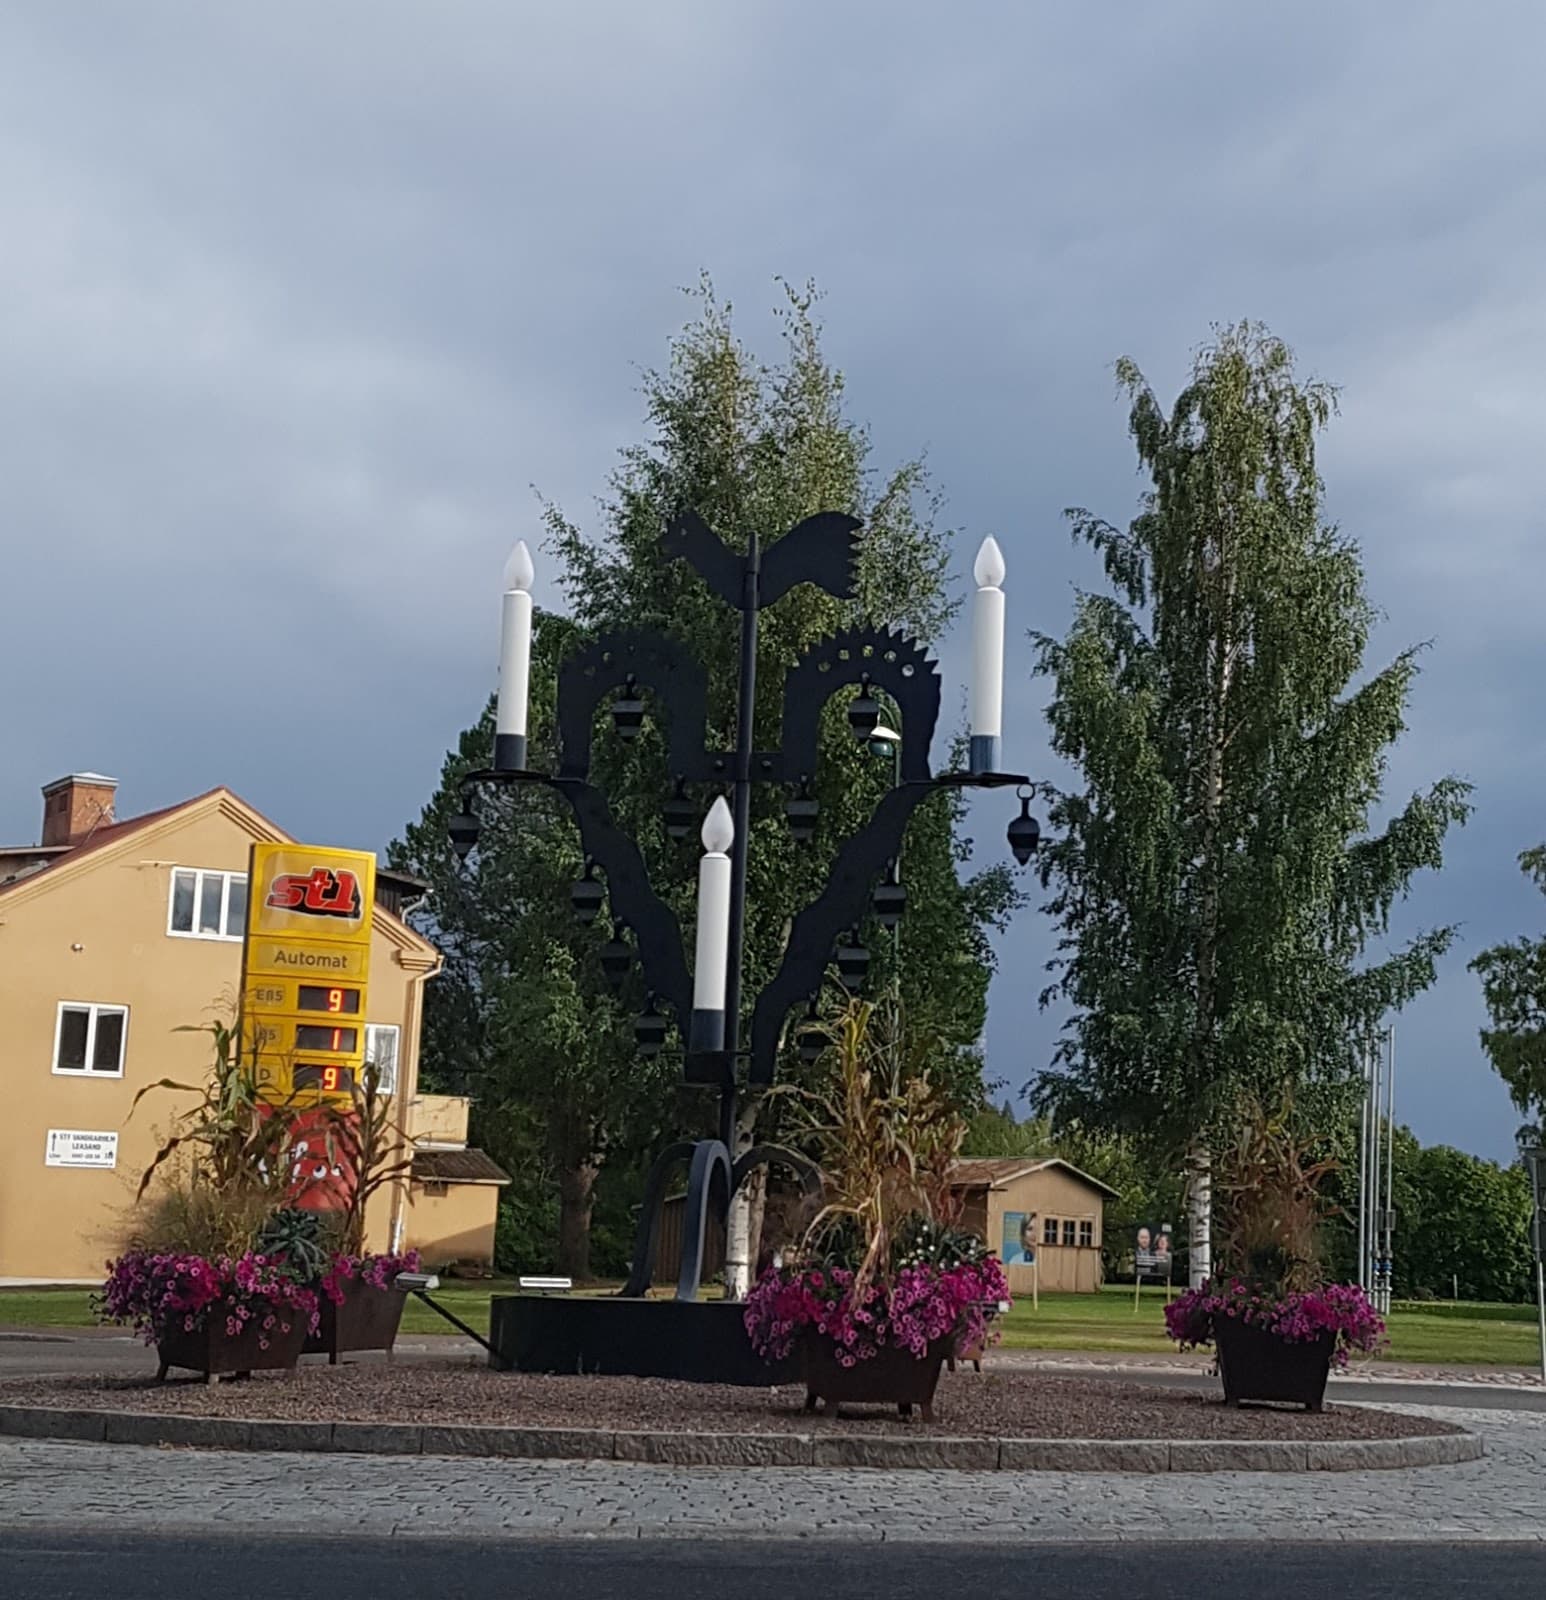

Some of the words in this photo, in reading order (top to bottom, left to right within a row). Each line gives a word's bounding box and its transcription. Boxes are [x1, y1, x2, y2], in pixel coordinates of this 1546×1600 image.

[274, 950, 348, 968] Automat
[328, 989, 343, 1012] 9
[260, 1069, 271, 1081] D
[323, 1067, 338, 1090] 9
